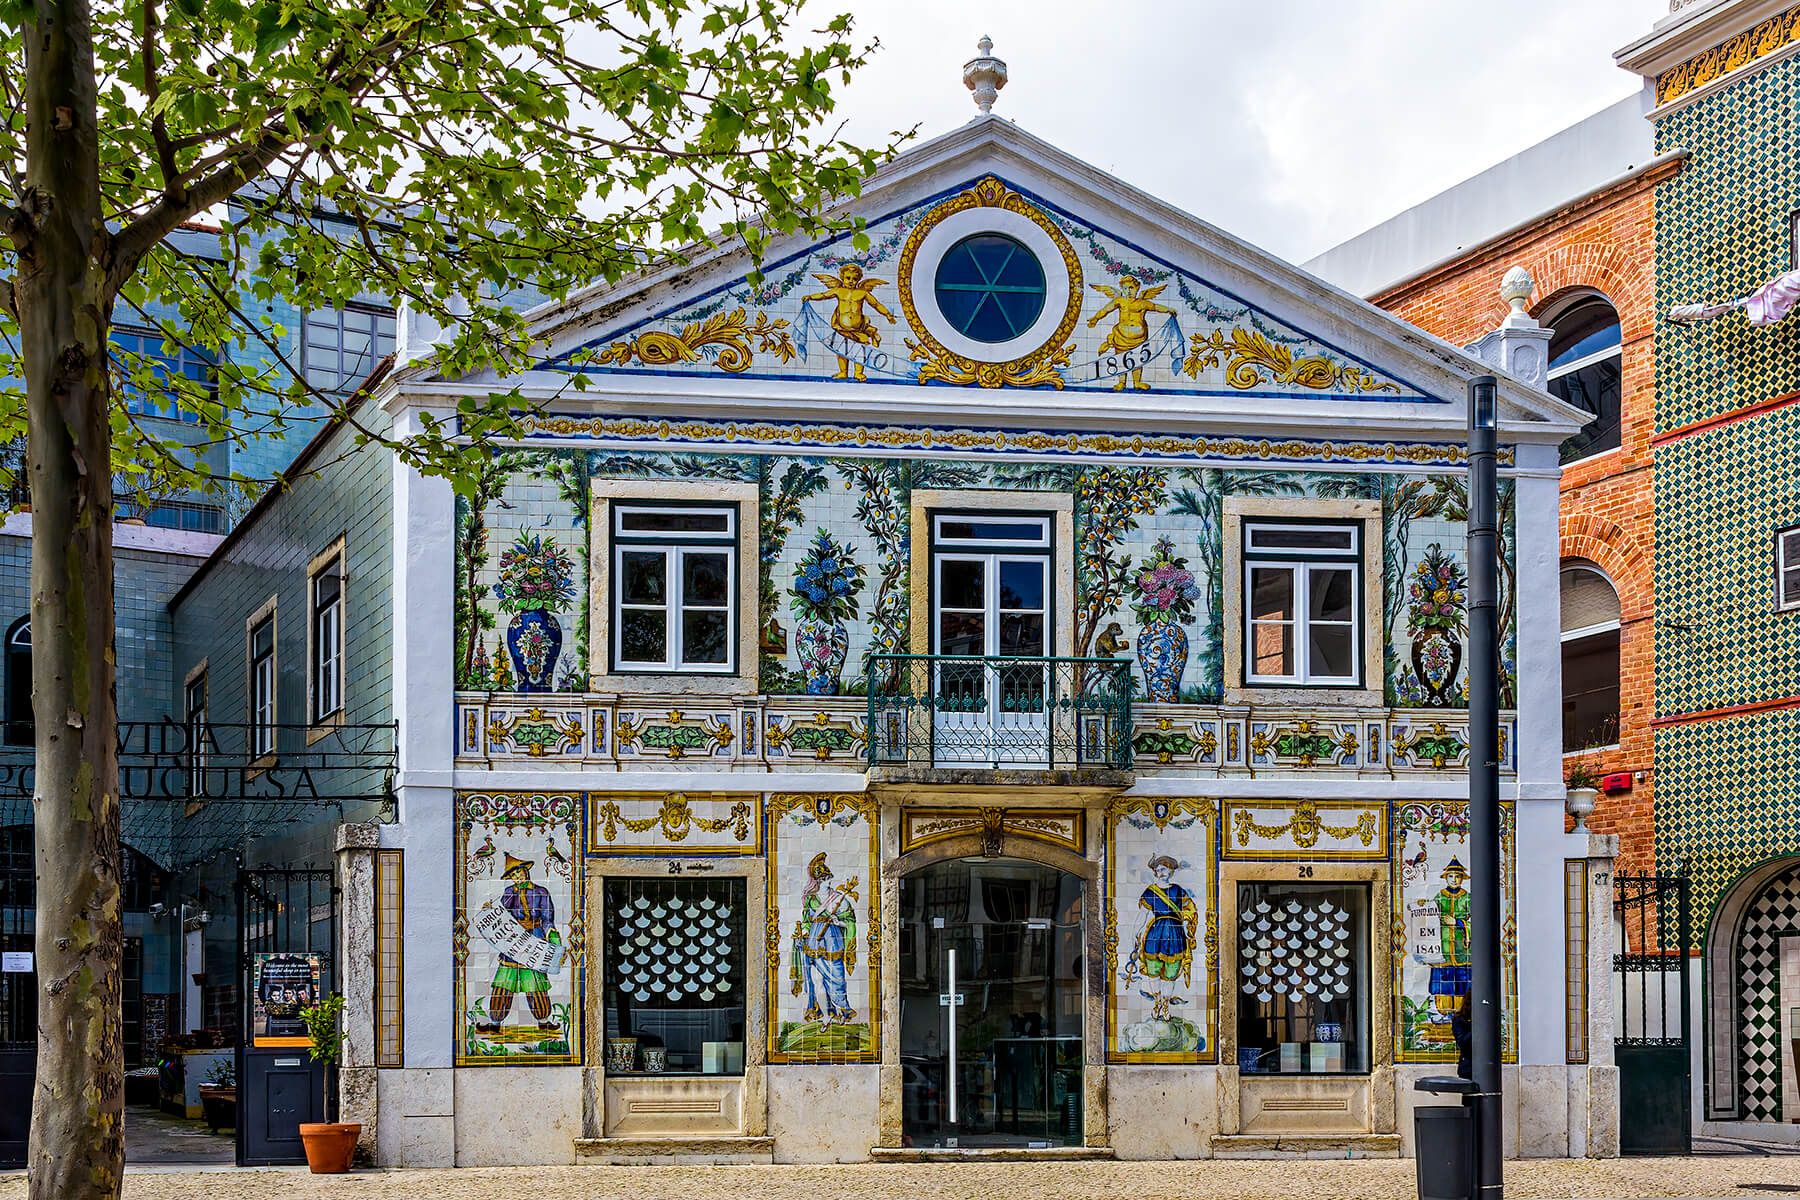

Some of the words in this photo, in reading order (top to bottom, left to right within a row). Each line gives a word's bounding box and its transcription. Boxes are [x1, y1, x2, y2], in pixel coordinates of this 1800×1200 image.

[823, 330, 888, 370] ANNO
[1095, 343, 1152, 378] 1865
[668, 861, 682, 874] 24
[1298, 865, 1313, 878] 26
[1594, 872, 1608, 885] 27
[476, 904, 505, 933] FABRICA
[1419, 927, 1436, 937] EM
[526, 940, 548, 969] COSTA
[1416, 944, 1440, 954] 1849
